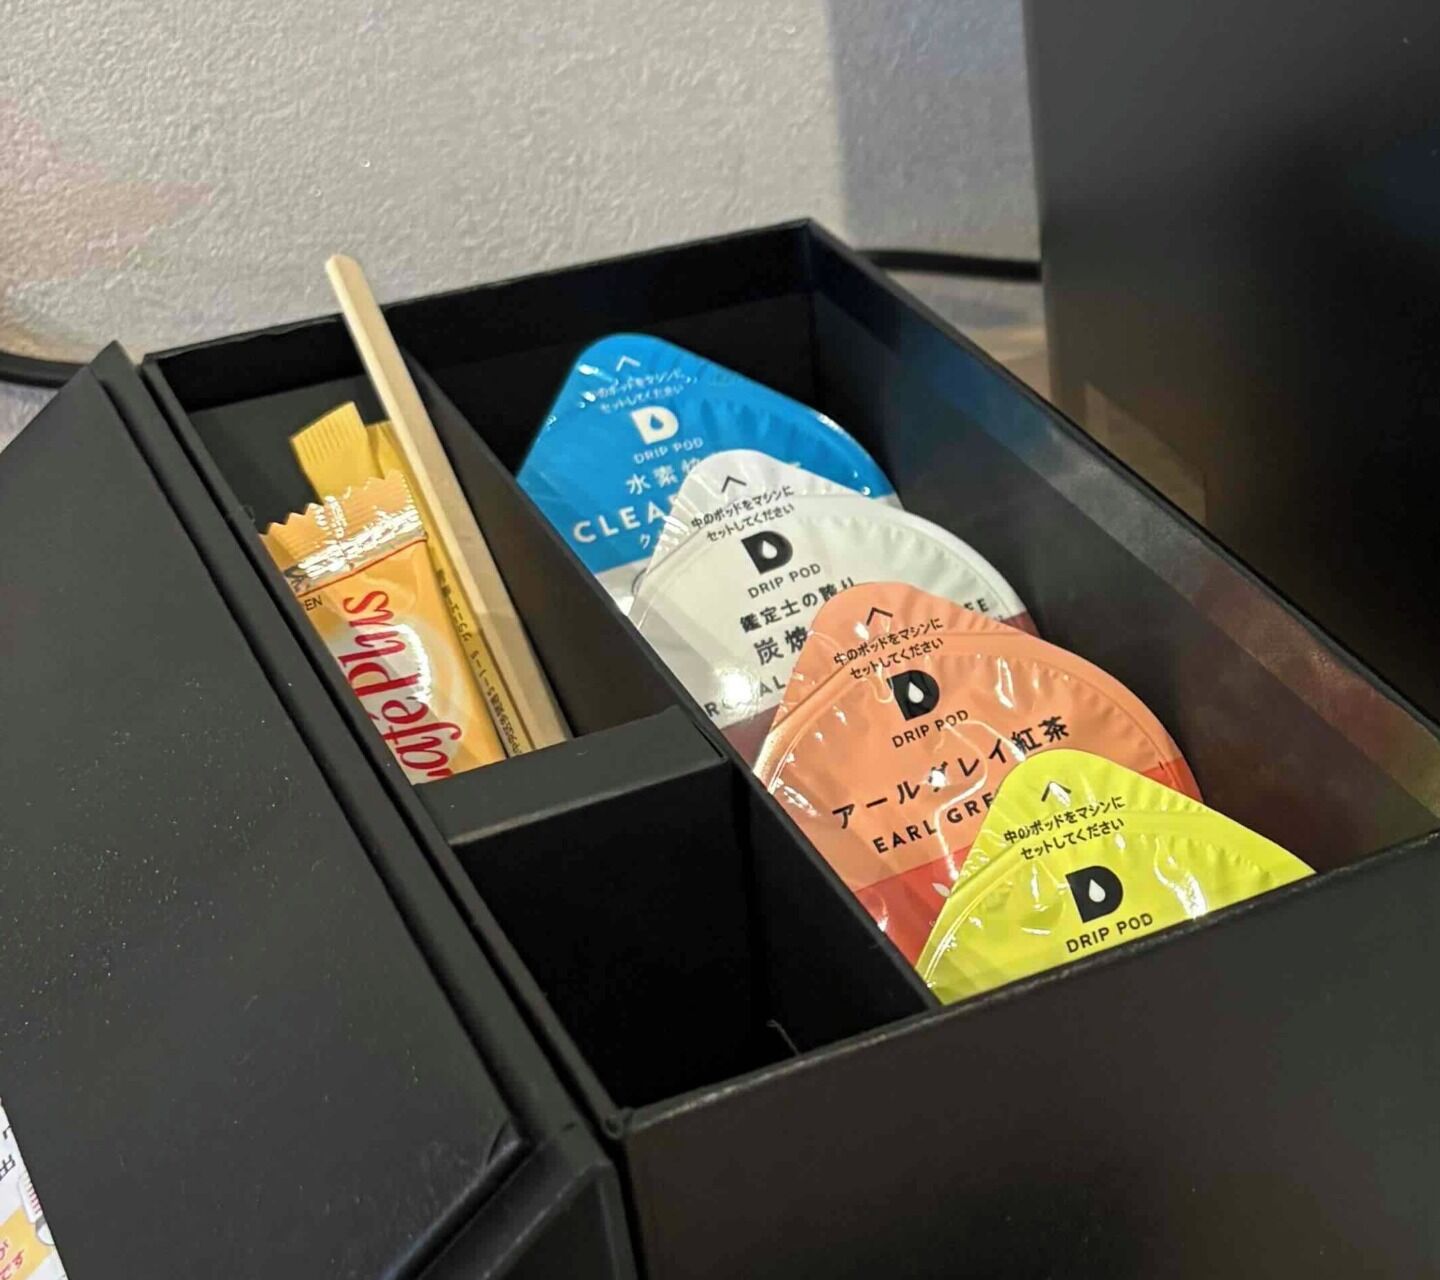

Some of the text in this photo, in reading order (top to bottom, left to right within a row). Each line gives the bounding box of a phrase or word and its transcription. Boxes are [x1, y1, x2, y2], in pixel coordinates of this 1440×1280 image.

[633, 436, 704, 465] DRIP POD
[573, 497, 680, 543] CLEA
[691, 485, 795, 529] 中のポッドをマシンに
[706, 503, 795, 543] セットしてください
[748, 563, 821, 600] DRIP POD
[833, 617, 944, 667] 中のポッドをマシンに
[850, 636, 945, 681] セットしてください
[892, 708, 969, 749] DRIP POD
[873, 791, 994, 855] EARL GRE
[1004, 795, 1126, 845] 中のポッドをマシンに
[1021, 818, 1125, 861] セットしてください
[1066, 912, 1154, 954] DRIP POD
